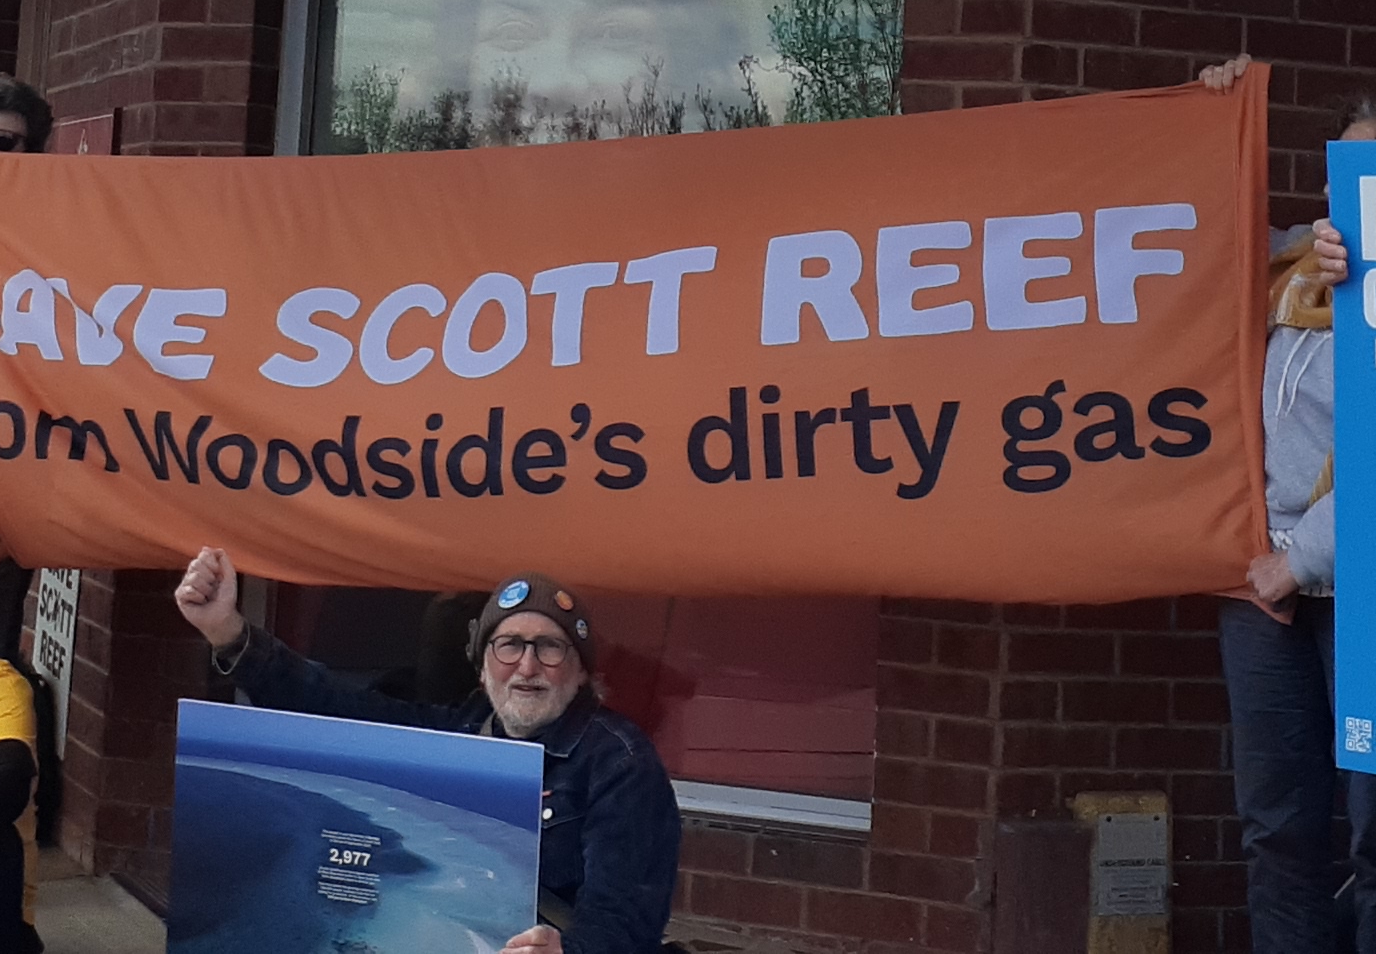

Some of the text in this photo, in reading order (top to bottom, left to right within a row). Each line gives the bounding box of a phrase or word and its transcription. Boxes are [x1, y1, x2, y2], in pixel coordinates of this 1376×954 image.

[258, 246, 717, 387] SCOTT
[760, 203, 1197, 346] REEF
[686, 384, 961, 500] dirty
[1001, 379, 1213, 494] gas
[39, 629, 67, 681] REEF
[329, 848, 371, 866] 2,977
